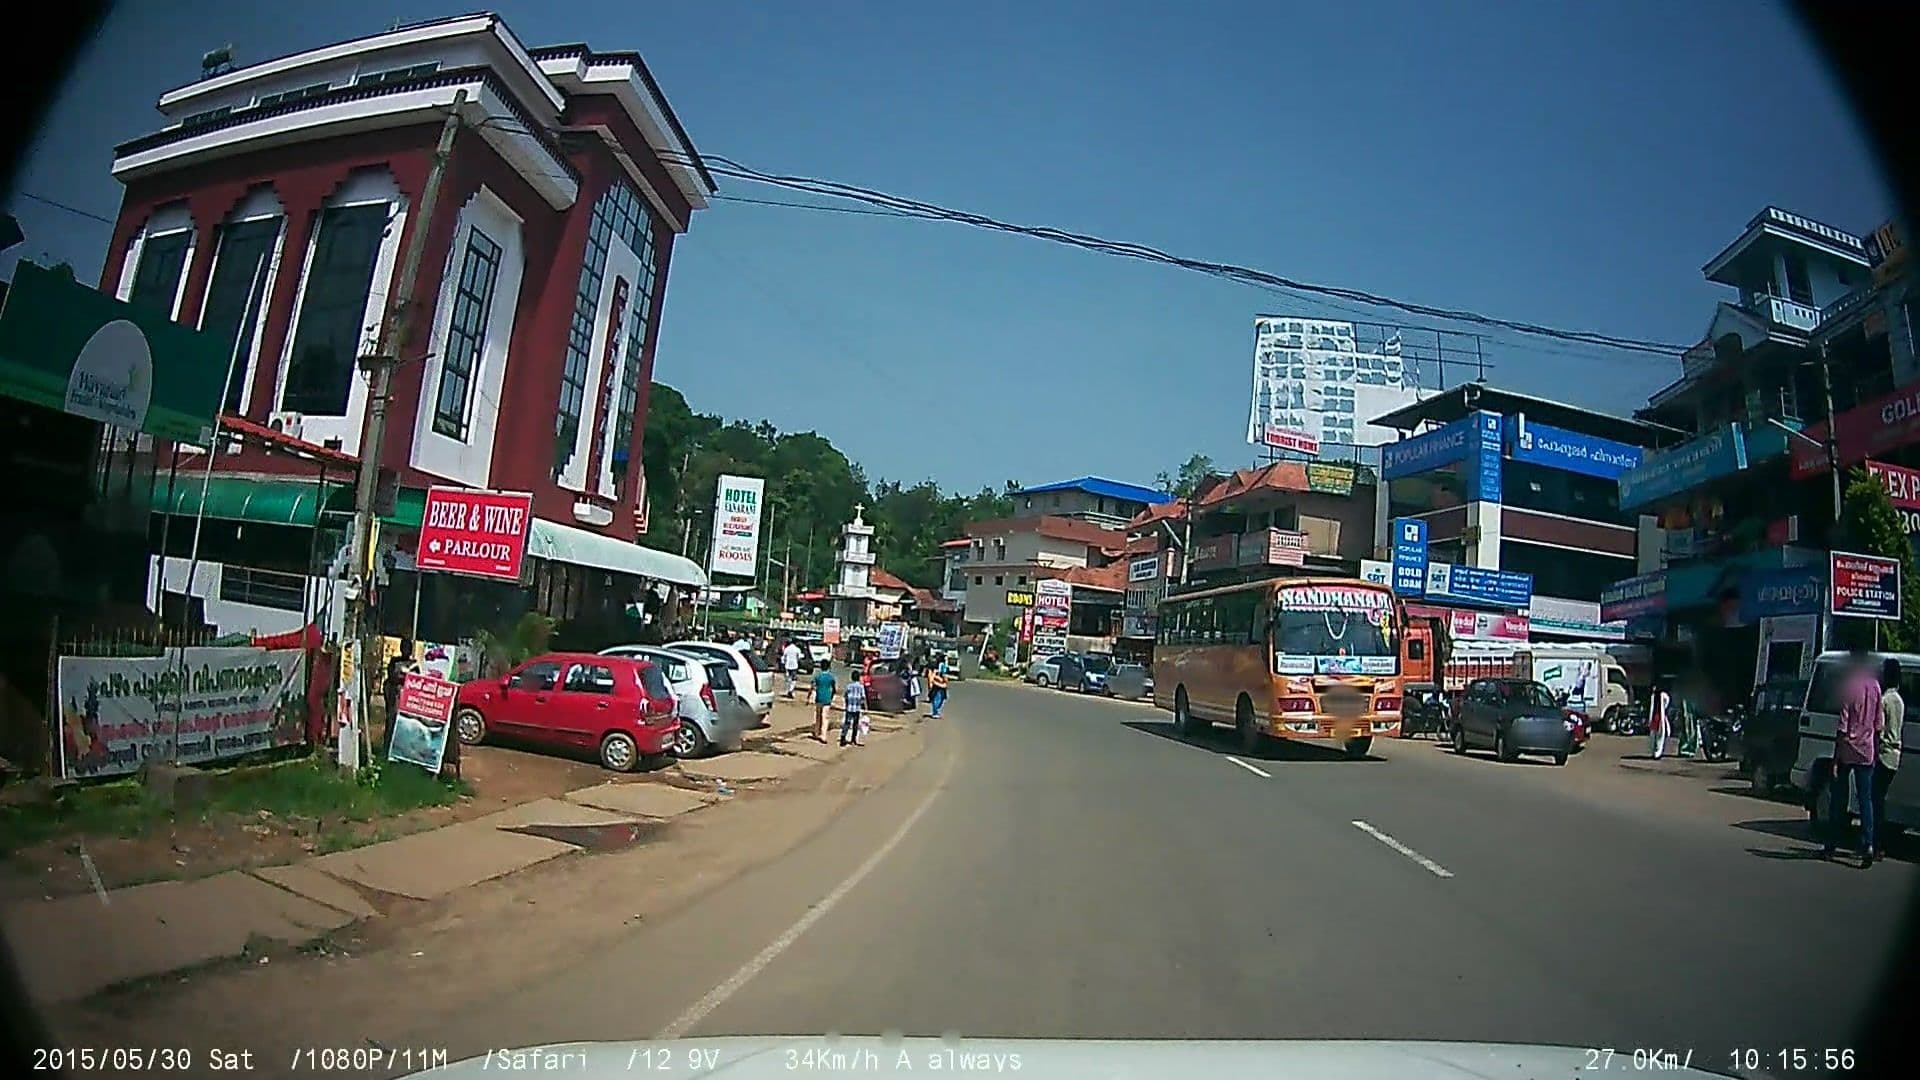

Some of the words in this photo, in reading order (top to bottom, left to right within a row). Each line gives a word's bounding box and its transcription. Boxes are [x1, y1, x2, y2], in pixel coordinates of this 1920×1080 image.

[725, 488, 757, 504] HOTEL
[429, 501, 467, 529] BEER
[469, 503, 480, 532] &
[484, 505, 524, 535] WINE
[443, 539, 511, 561] PARLOUR
[719, 550, 753, 562] ROOMS
[1398, 567, 1422, 579] GOLD
[1430, 573, 1447, 584] SBT
[1398, 578, 1422, 590] LOAN
[1836, 586, 1863, 597] POLICE
[1865, 589, 1895, 600] STATION
[1038, 595, 1068, 609] HOTEL
